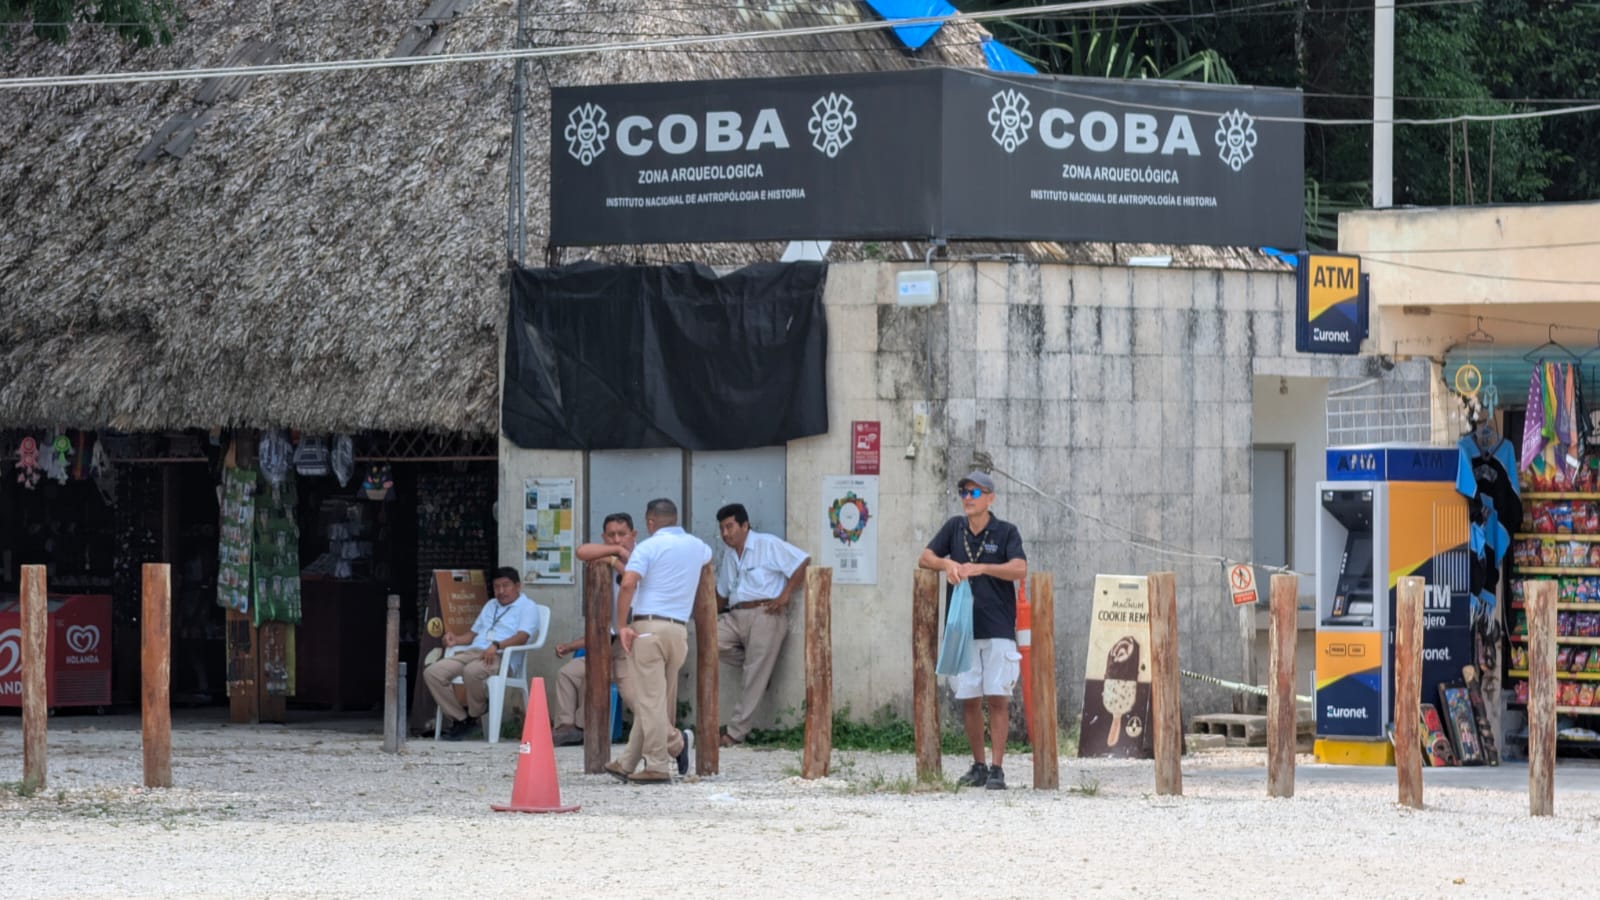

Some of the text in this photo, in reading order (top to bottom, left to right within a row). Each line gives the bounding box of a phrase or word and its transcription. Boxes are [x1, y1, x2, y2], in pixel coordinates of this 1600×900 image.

[615, 108, 790, 156] COBA
[1039, 107, 1201, 156] COBA
[638, 169, 669, 184] ZONA
[1062, 164, 1179, 184] ZONA ARQUEOLÓGICA
[606, 196, 644, 208] INSTITUTO
[645, 194, 684, 206] NACIONAL
[686, 193, 697, 204] DE
[760, 189, 767, 200] E
[767, 187, 806, 200] HISTORIA
[1030, 189, 1069, 201] INSTITUTO
[1069, 191, 1106, 203] NACIONAL
[1107, 193, 1118, 204] DE
[1176, 195, 1182, 206] E
[1182, 195, 1217, 207] HISTORIA
[1313, 265, 1354, 289] ATM
[1424, 584, 1451, 608] TM
[1098, 610, 1126, 622] COOKIE
[1422, 613, 1446, 630] ajero
